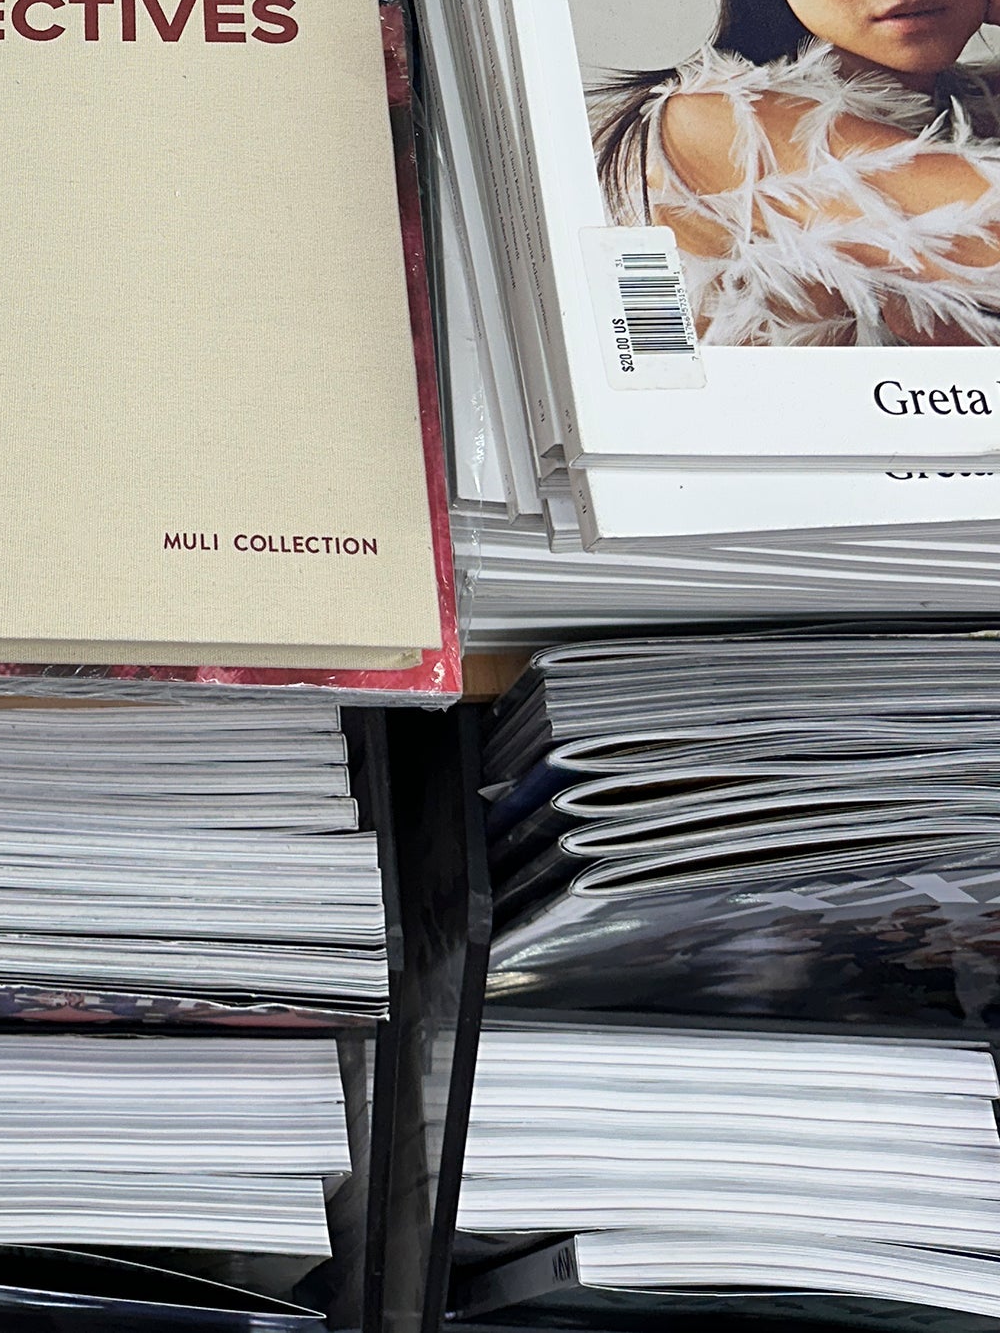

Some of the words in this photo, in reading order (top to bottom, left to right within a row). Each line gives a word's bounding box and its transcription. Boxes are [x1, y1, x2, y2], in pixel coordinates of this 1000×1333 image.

[612, 318, 627, 334] US
[616, 337, 635, 372] $20.00
[873, 381, 991, 416] Greta
[163, 532, 220, 552] MULI
[233, 534, 379, 556] COLLECTION
